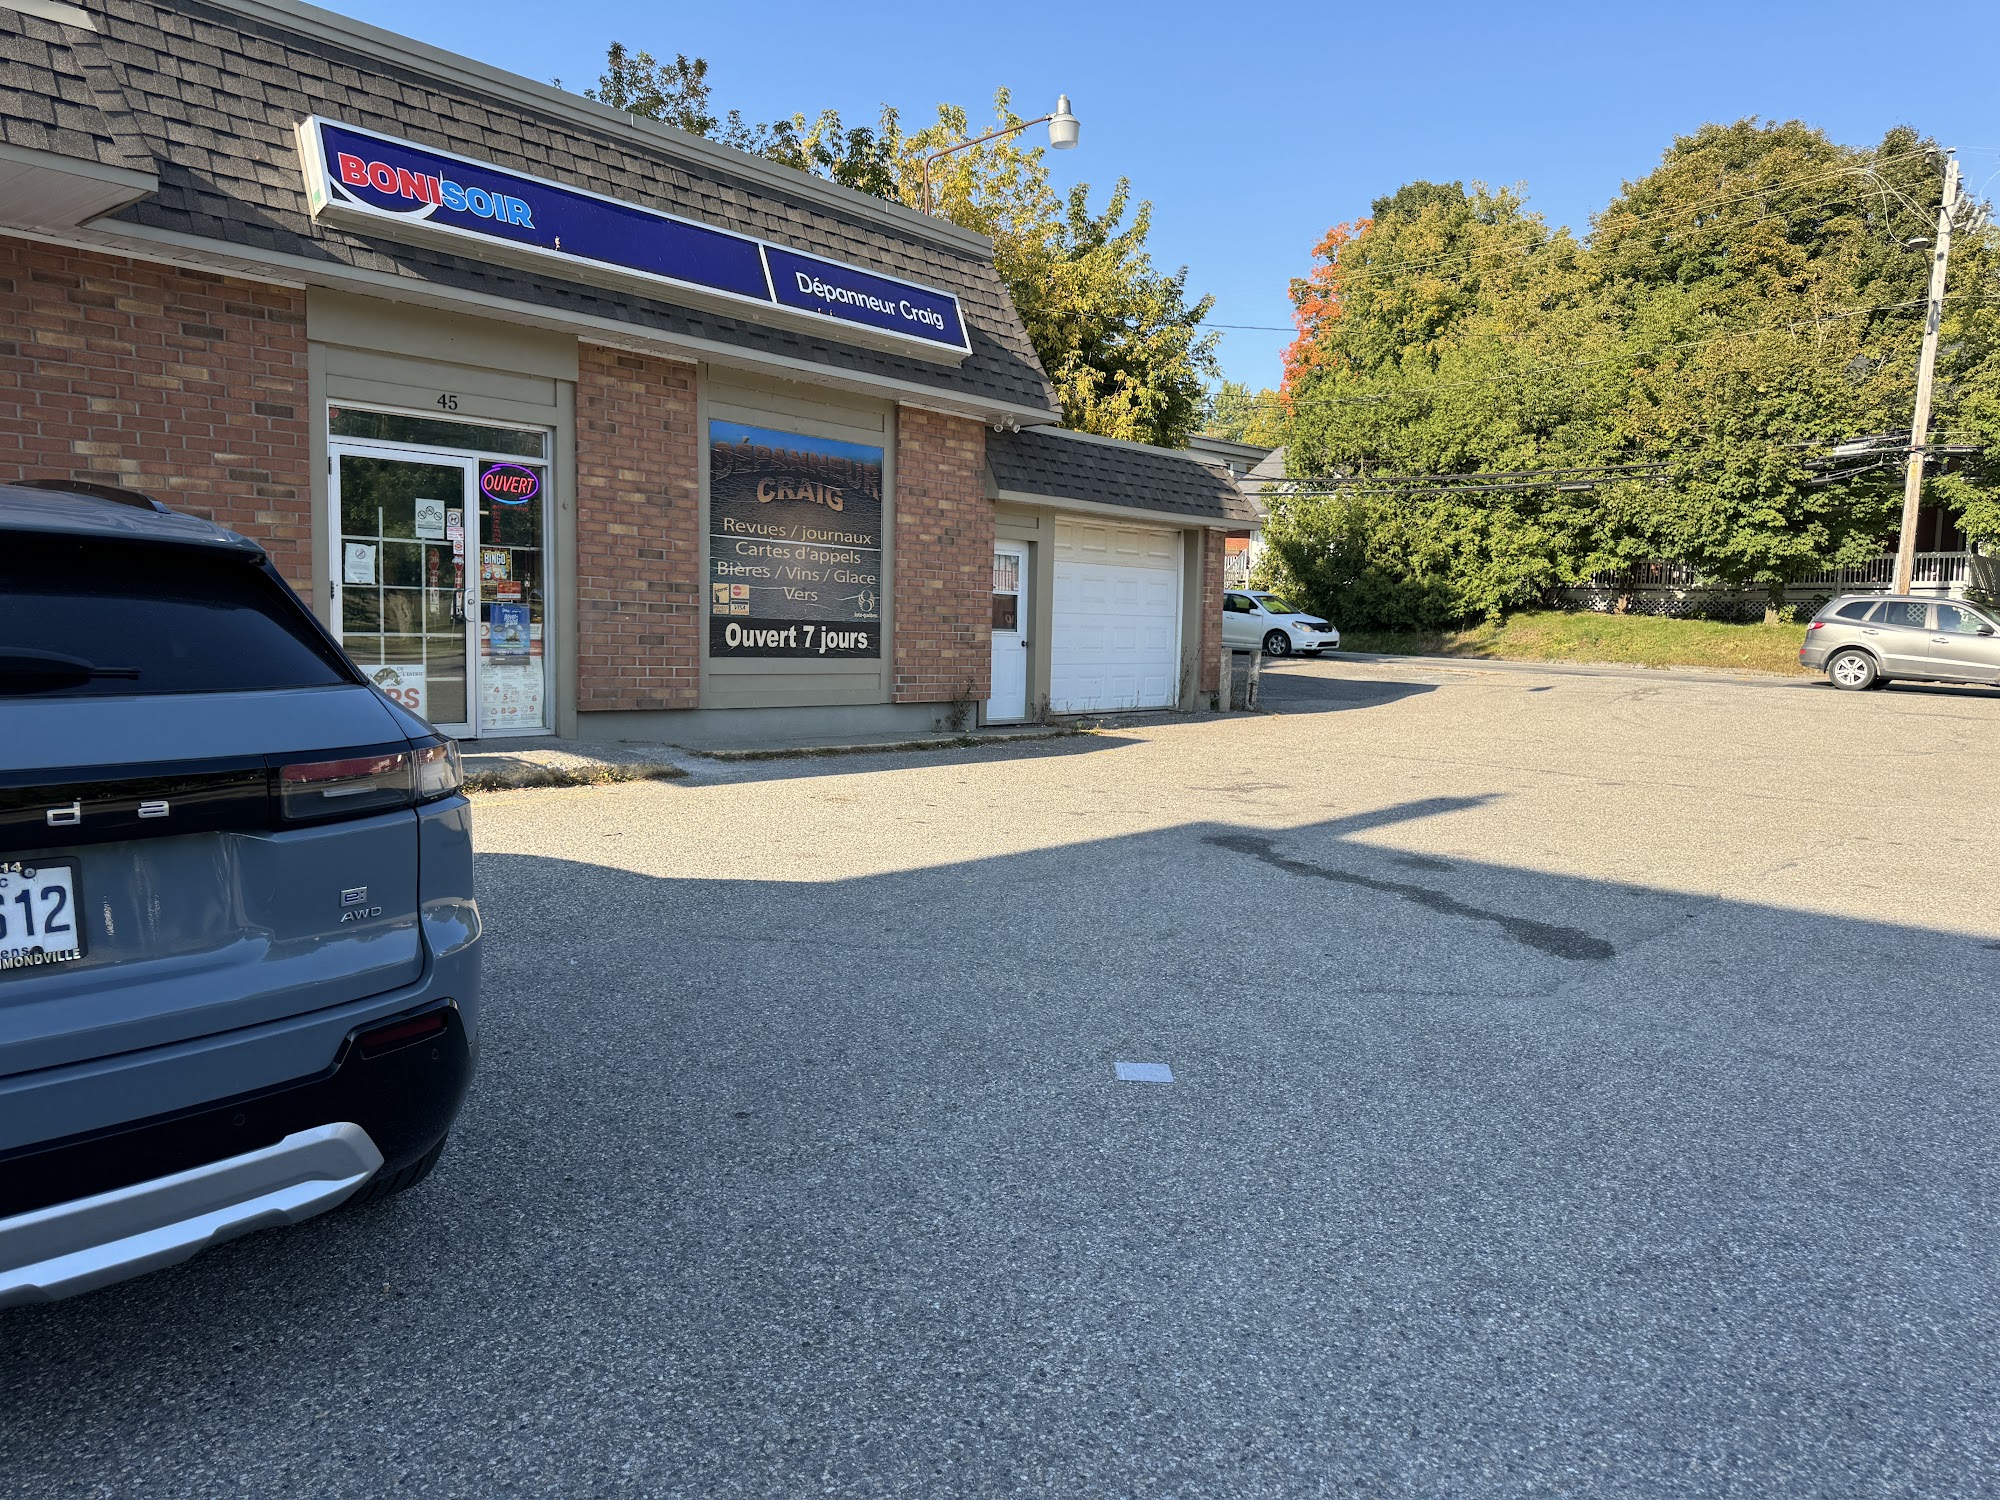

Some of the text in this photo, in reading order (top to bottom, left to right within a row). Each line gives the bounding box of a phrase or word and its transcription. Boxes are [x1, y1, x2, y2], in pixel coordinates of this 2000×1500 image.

[337, 151, 536, 229] BONISOIR
[795, 271, 944, 331] Dépanneur Craig
[436, 394, 458, 411] 45
[484, 474, 535, 494] OUVERT
[756, 476, 844, 512] CRAIG
[723, 518, 786, 537] Revues
[801, 526, 872, 545] journaux
[484, 552, 506, 565] BINGO
[736, 541, 861, 565] Cartes d'appels
[717, 562, 771, 579] Bières
[785, 566, 820, 581] Vins
[834, 570, 876, 585] Glace
[783, 586, 818, 601] Vers
[725, 622, 868, 654] Ouvert 7 jours
[493, 686, 500, 694] 4
[502, 693, 508, 701] 5
[341, 906, 382, 922] AWD
